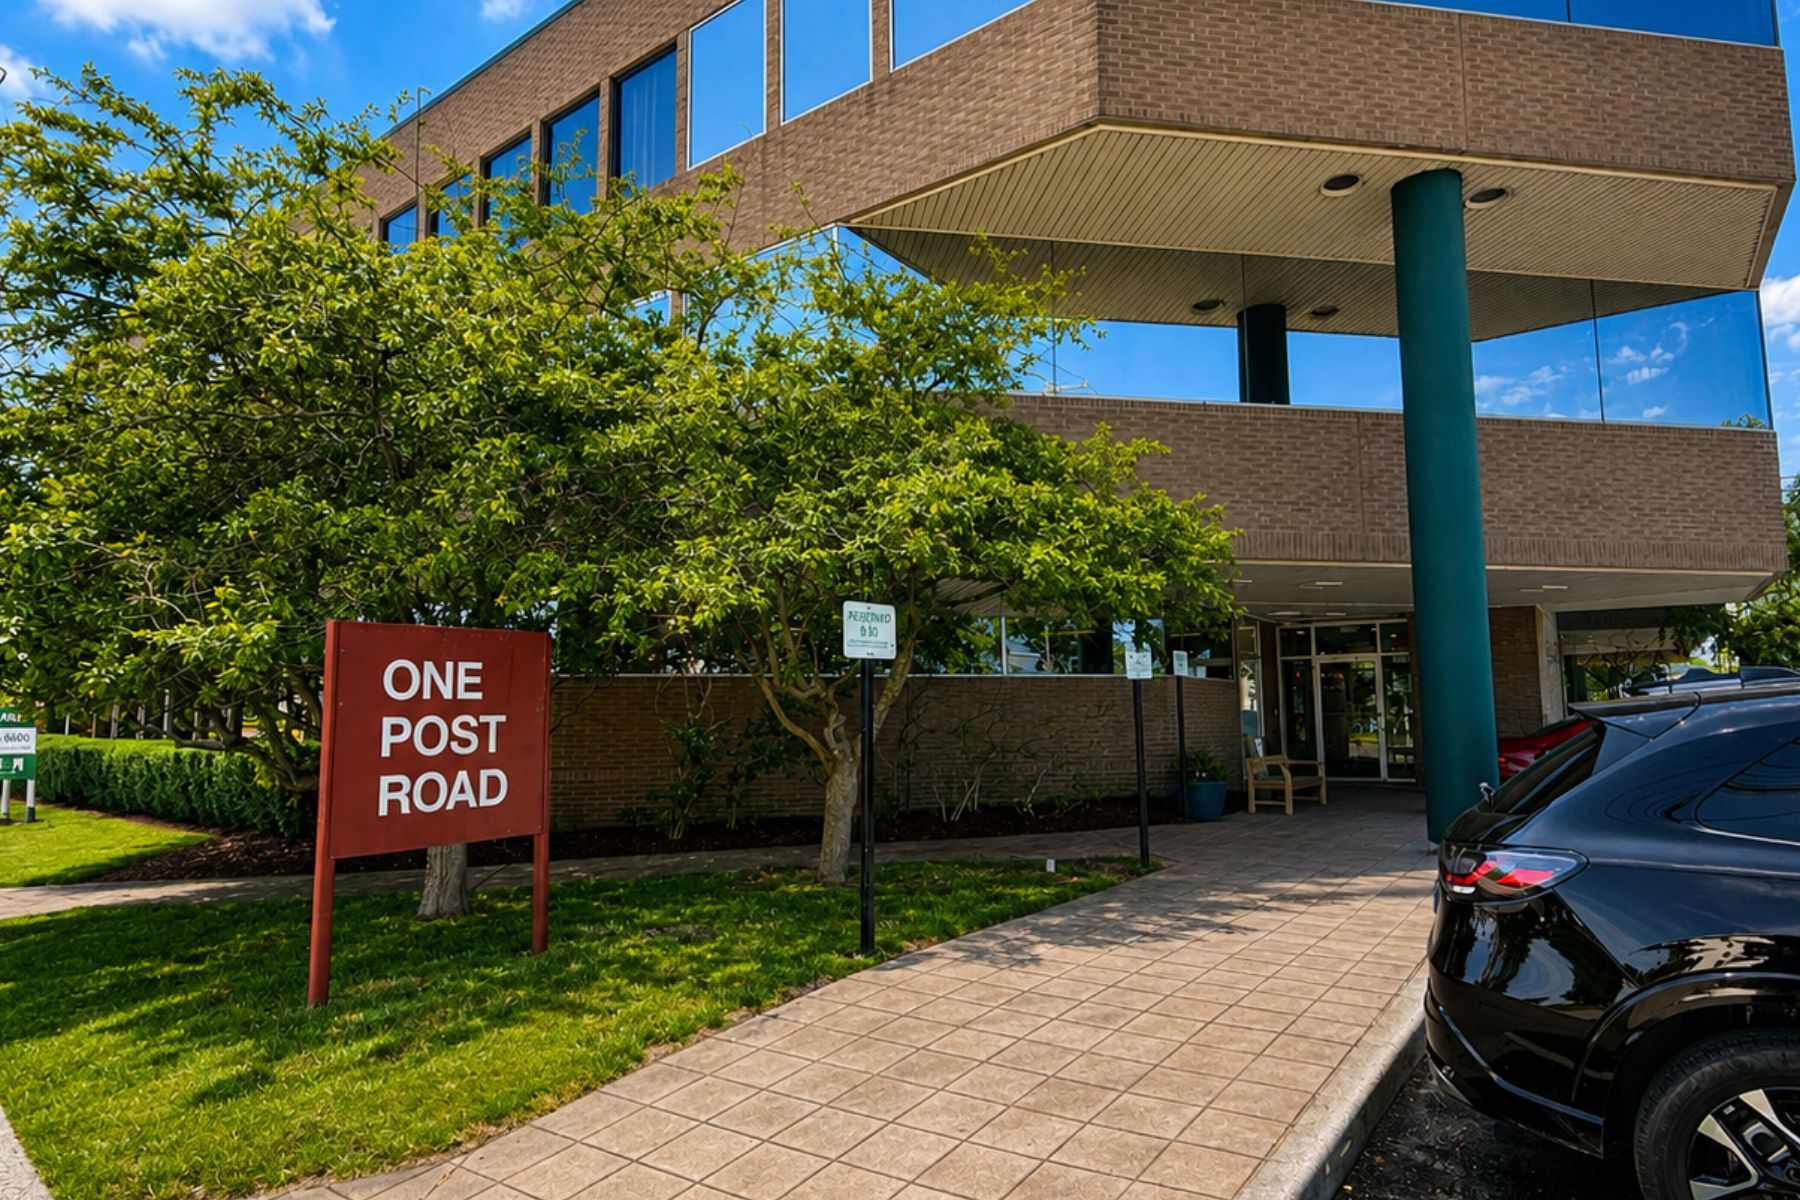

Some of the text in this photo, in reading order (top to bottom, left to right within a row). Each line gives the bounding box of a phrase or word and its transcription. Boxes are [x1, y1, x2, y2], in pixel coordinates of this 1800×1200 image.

[383, 659, 483, 701] ONE
[381, 714, 507, 758] POST
[378, 768, 508, 817] ROAD
